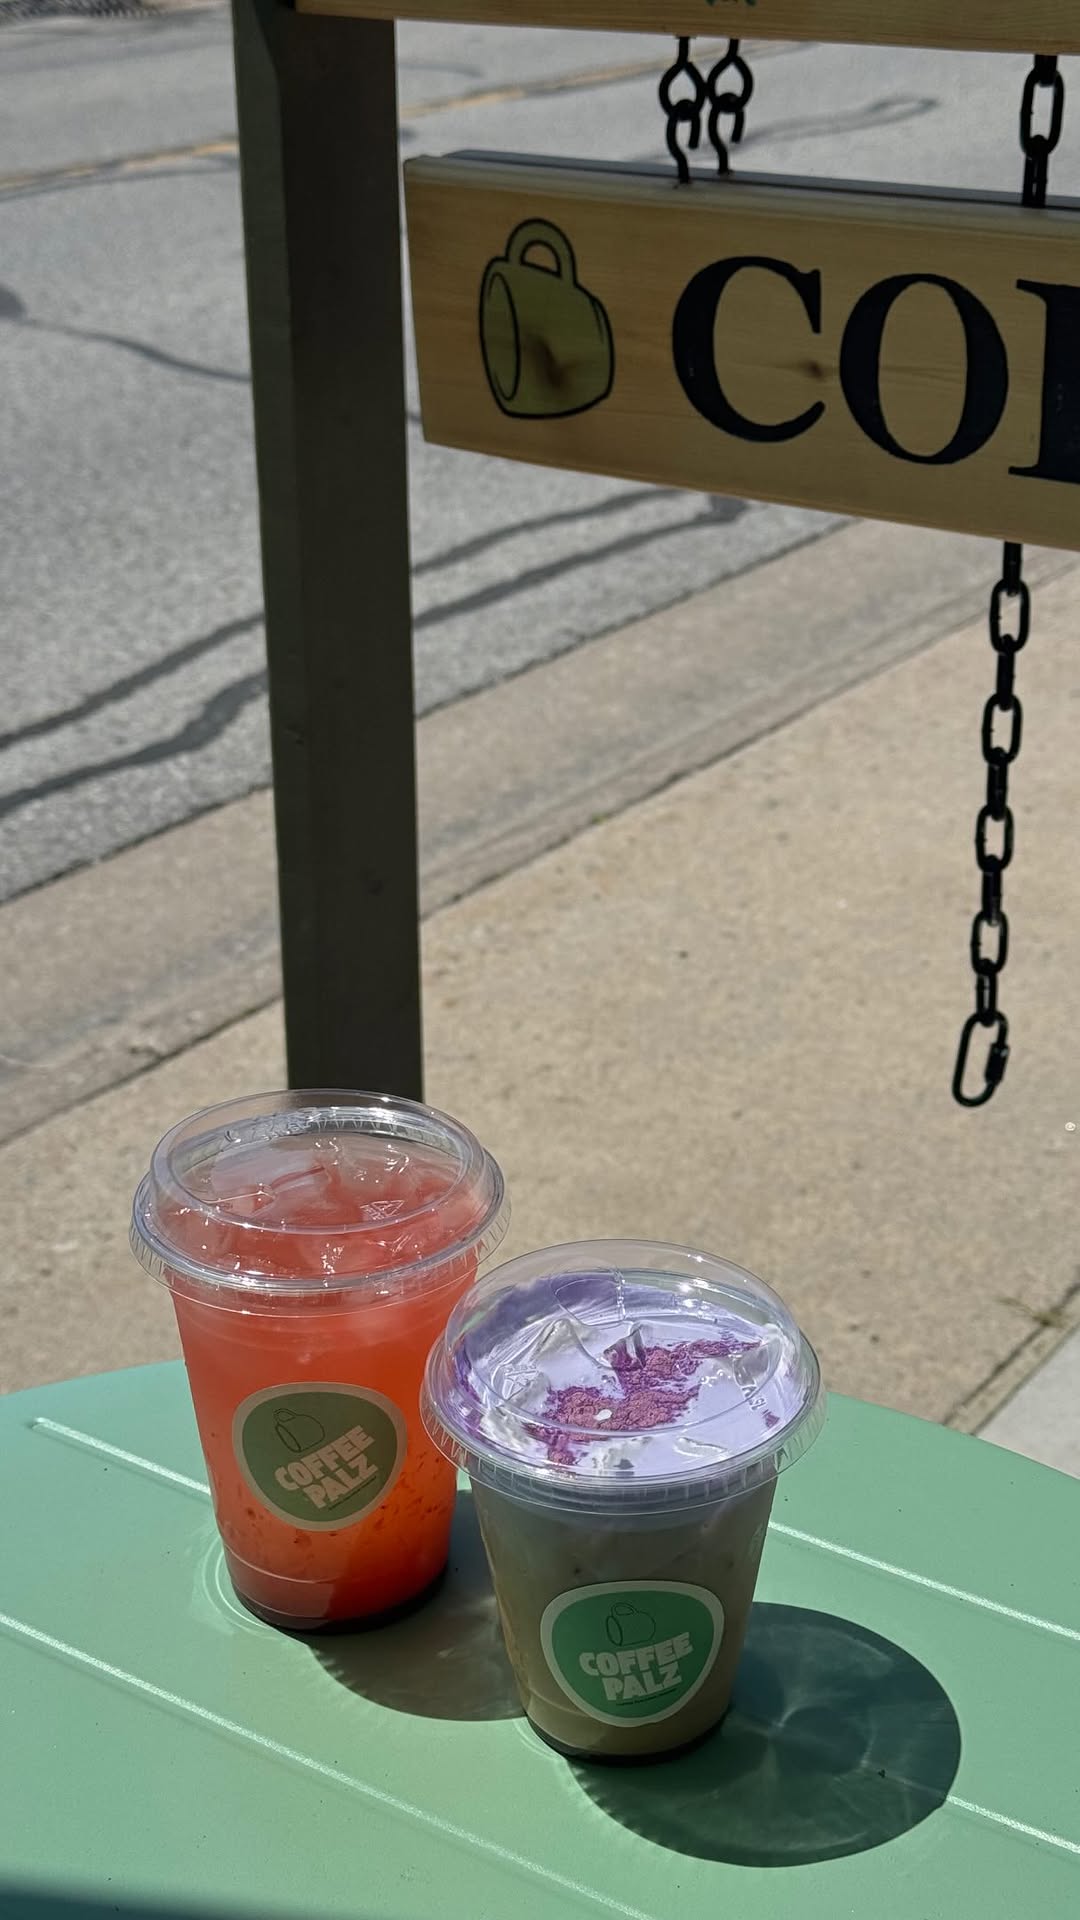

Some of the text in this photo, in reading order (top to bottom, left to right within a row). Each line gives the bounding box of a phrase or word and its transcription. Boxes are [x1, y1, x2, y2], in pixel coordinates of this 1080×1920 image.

[274, 1425, 375, 1491] COFFEE
[303, 1453, 379, 1509] PALZ
[578, 1631, 694, 1676] COFFEE
[602, 1661, 682, 1701] PALZ
